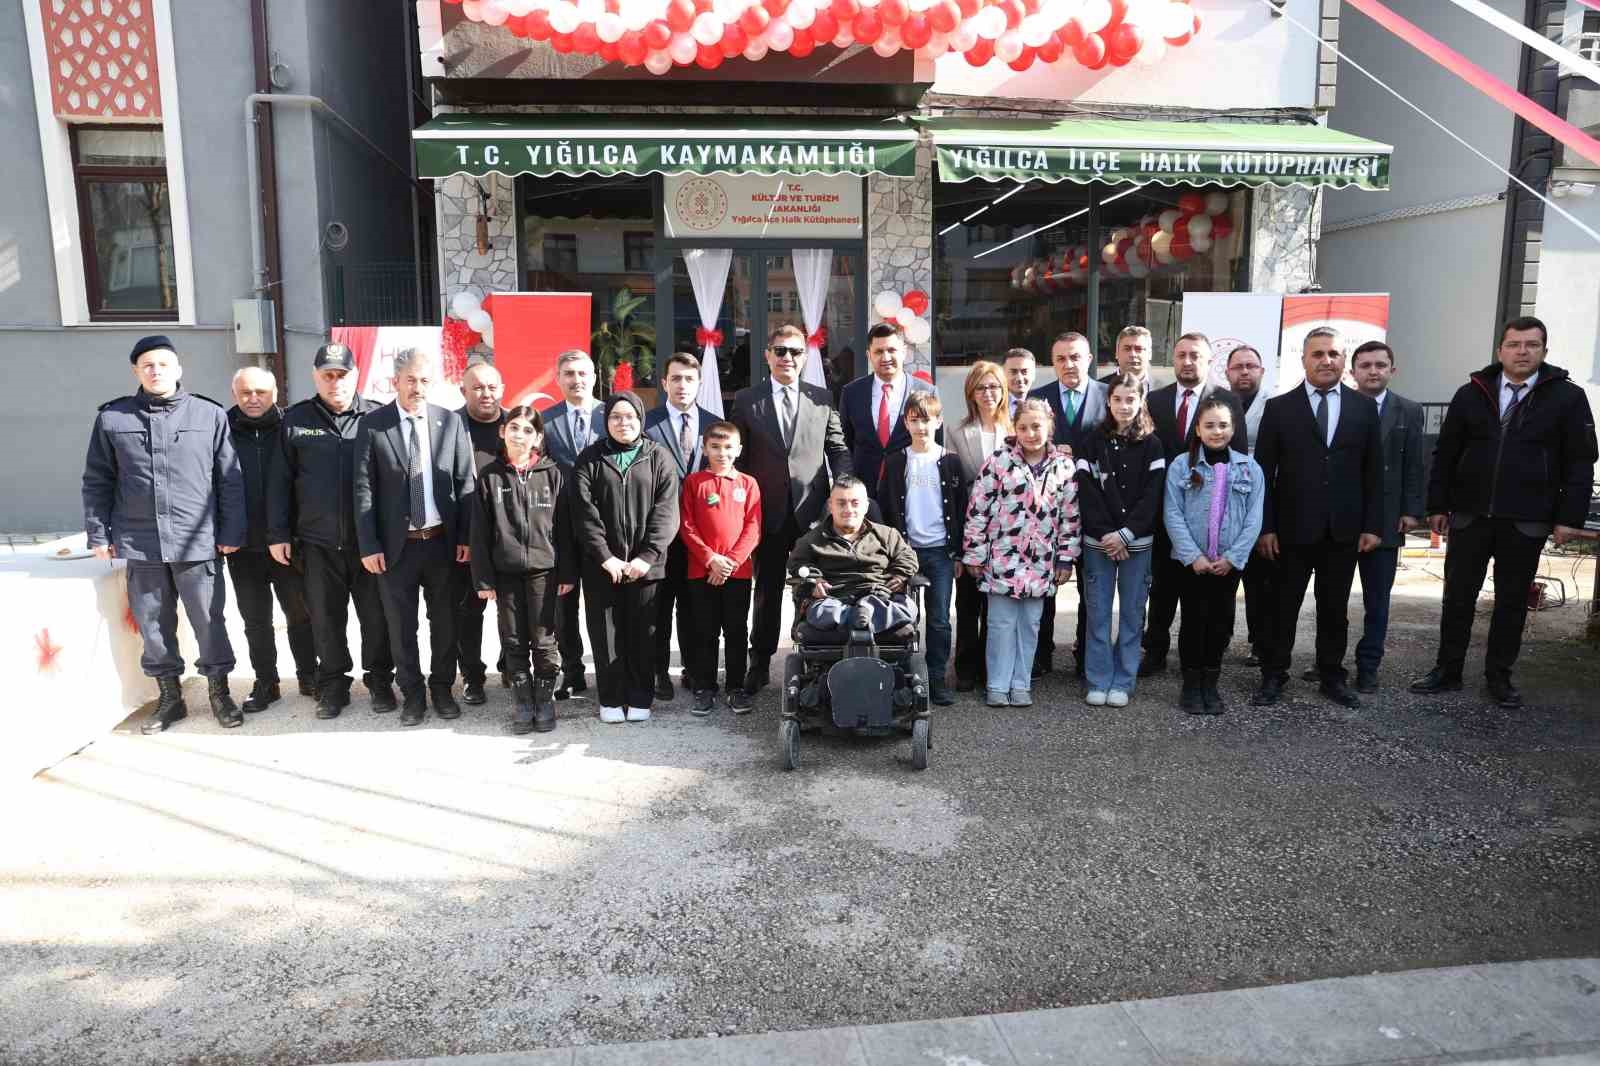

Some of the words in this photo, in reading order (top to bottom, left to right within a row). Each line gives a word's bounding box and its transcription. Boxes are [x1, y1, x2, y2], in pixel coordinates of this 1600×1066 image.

[456, 145, 510, 166] T.C.
[526, 140, 639, 166] YIĞILCA
[660, 141, 876, 166] KAYMAKAMLIĞI
[951, 146, 1049, 170] YIĞILCA
[1068, 148, 1121, 177] İLÇE
[1139, 152, 1201, 173] HALK
[1219, 151, 1379, 178] KÜTÜPHANESİ
[786, 183, 804, 192] T.C.
[789, 194, 802, 202] VE
[782, 215, 801, 224] Halk
[803, 215, 860, 225] Kütüphanesi
